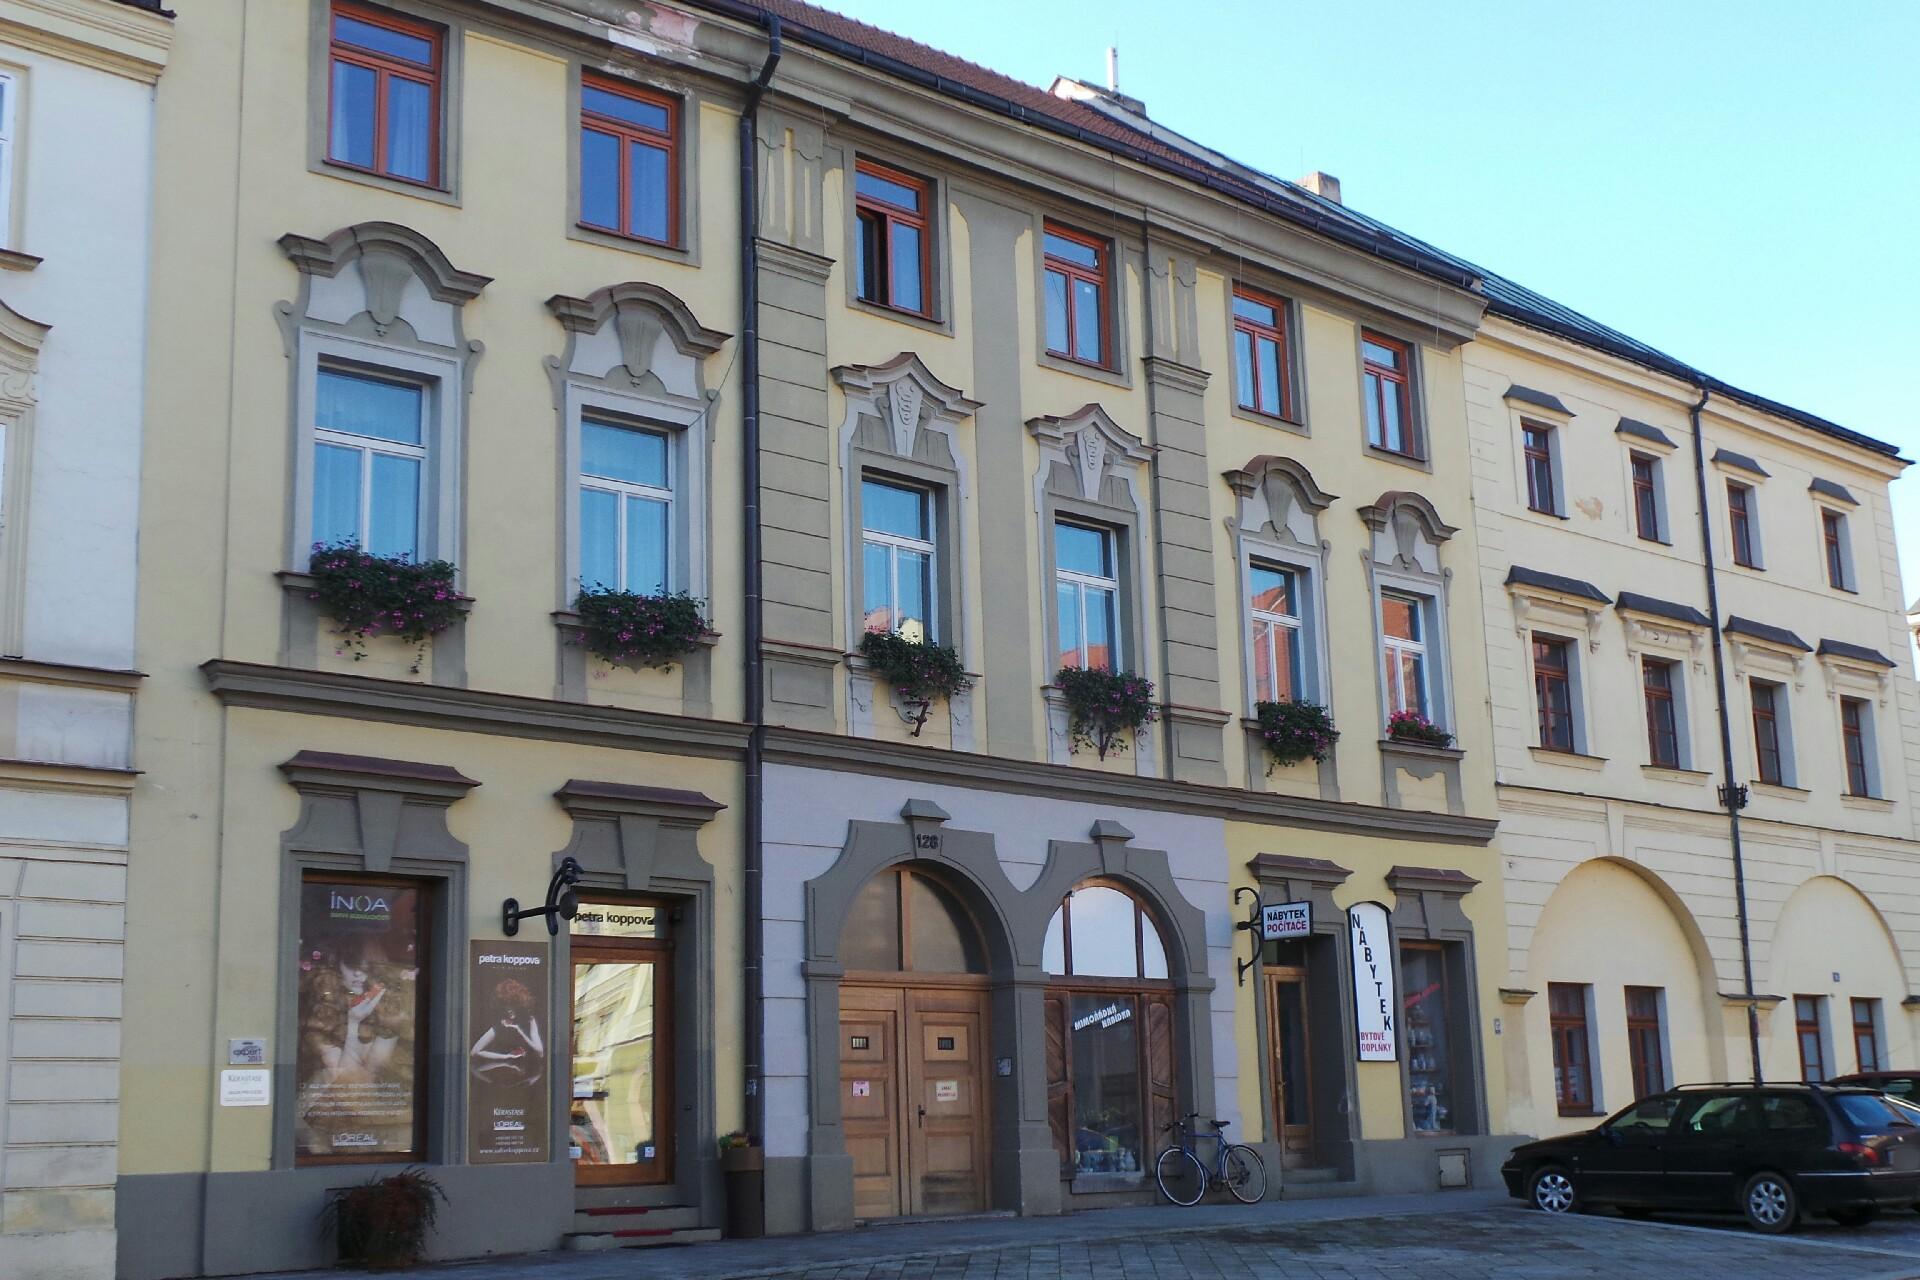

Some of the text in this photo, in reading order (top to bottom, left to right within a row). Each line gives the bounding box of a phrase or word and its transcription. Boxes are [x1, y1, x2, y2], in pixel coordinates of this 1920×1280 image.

[574, 912, 656, 926] petra koppova
[1267, 909, 1306, 921] NÁBYTEK
[1267, 919, 1307, 932] POČÍTAČE
[479, 954, 540, 966] petra koppova
[1351, 913, 1392, 1031] NÁBYTEK
